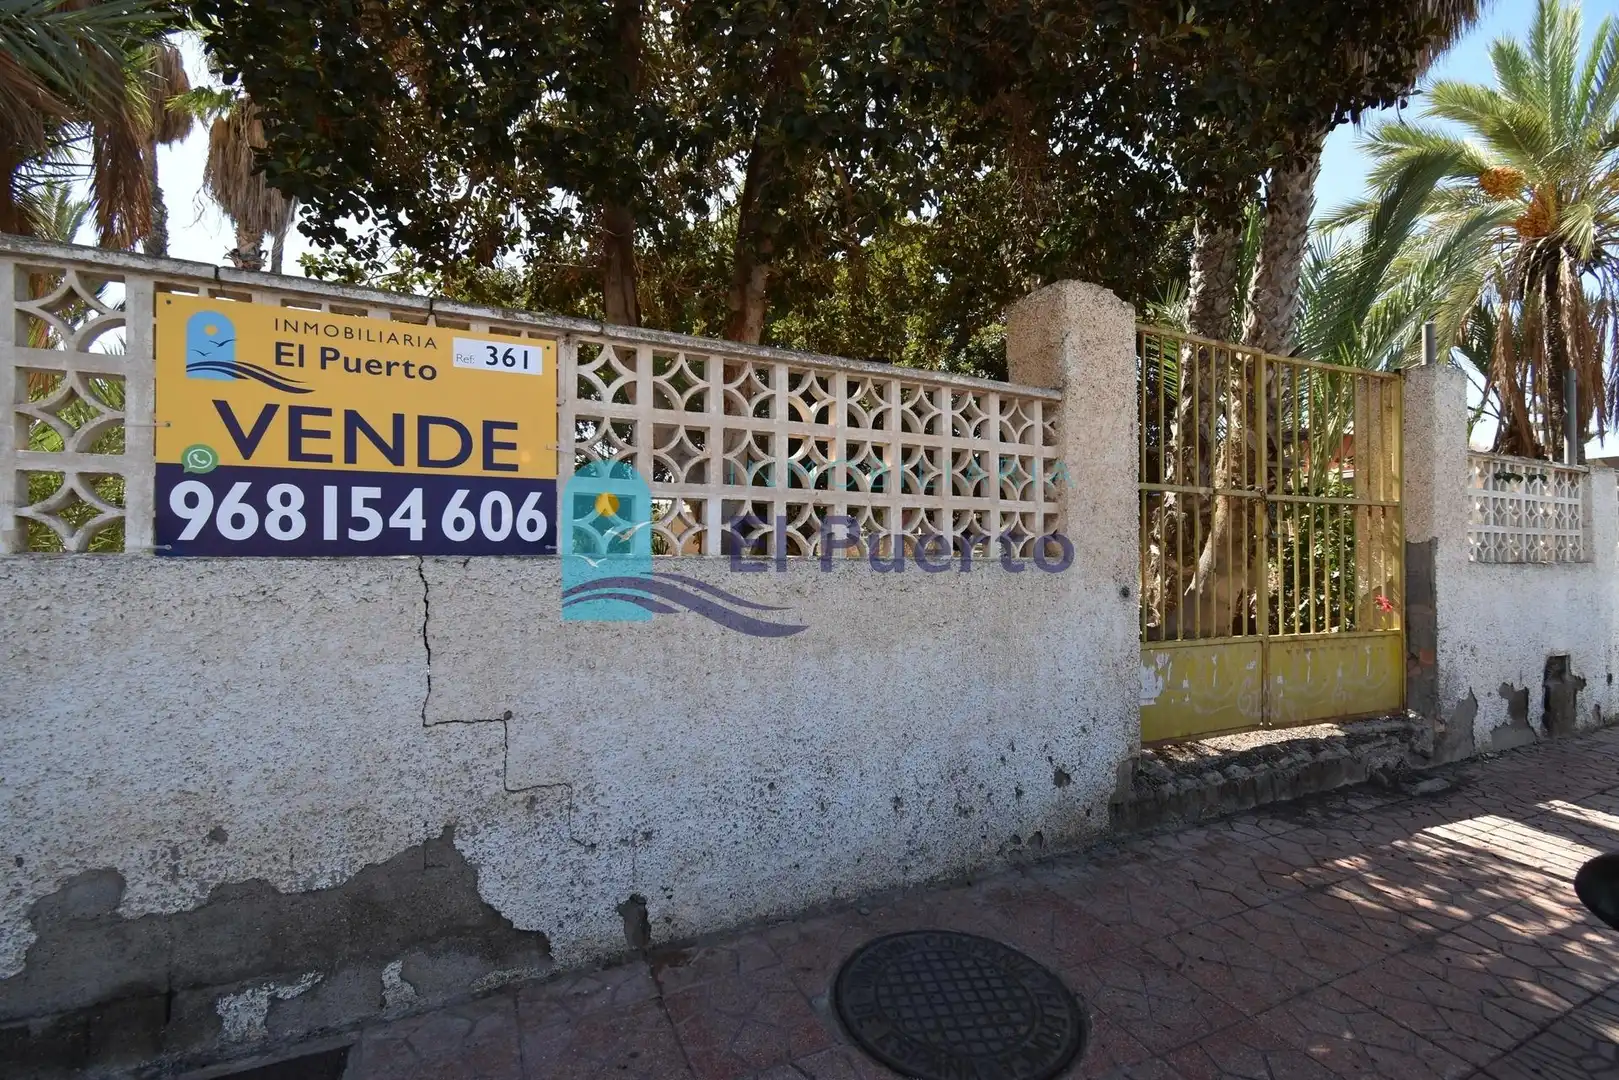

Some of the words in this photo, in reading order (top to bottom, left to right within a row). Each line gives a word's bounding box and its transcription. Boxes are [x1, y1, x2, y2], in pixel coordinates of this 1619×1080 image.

[275, 318, 438, 349] INMOBILIARIA
[275, 341, 305, 368] El
[320, 346, 437, 381] Puerto
[485, 345, 529, 370] 361
[211, 399, 519, 472] VENDE
[168, 480, 307, 542] 968
[322, 485, 427, 542] 154
[441, 489, 548, 543] 606
